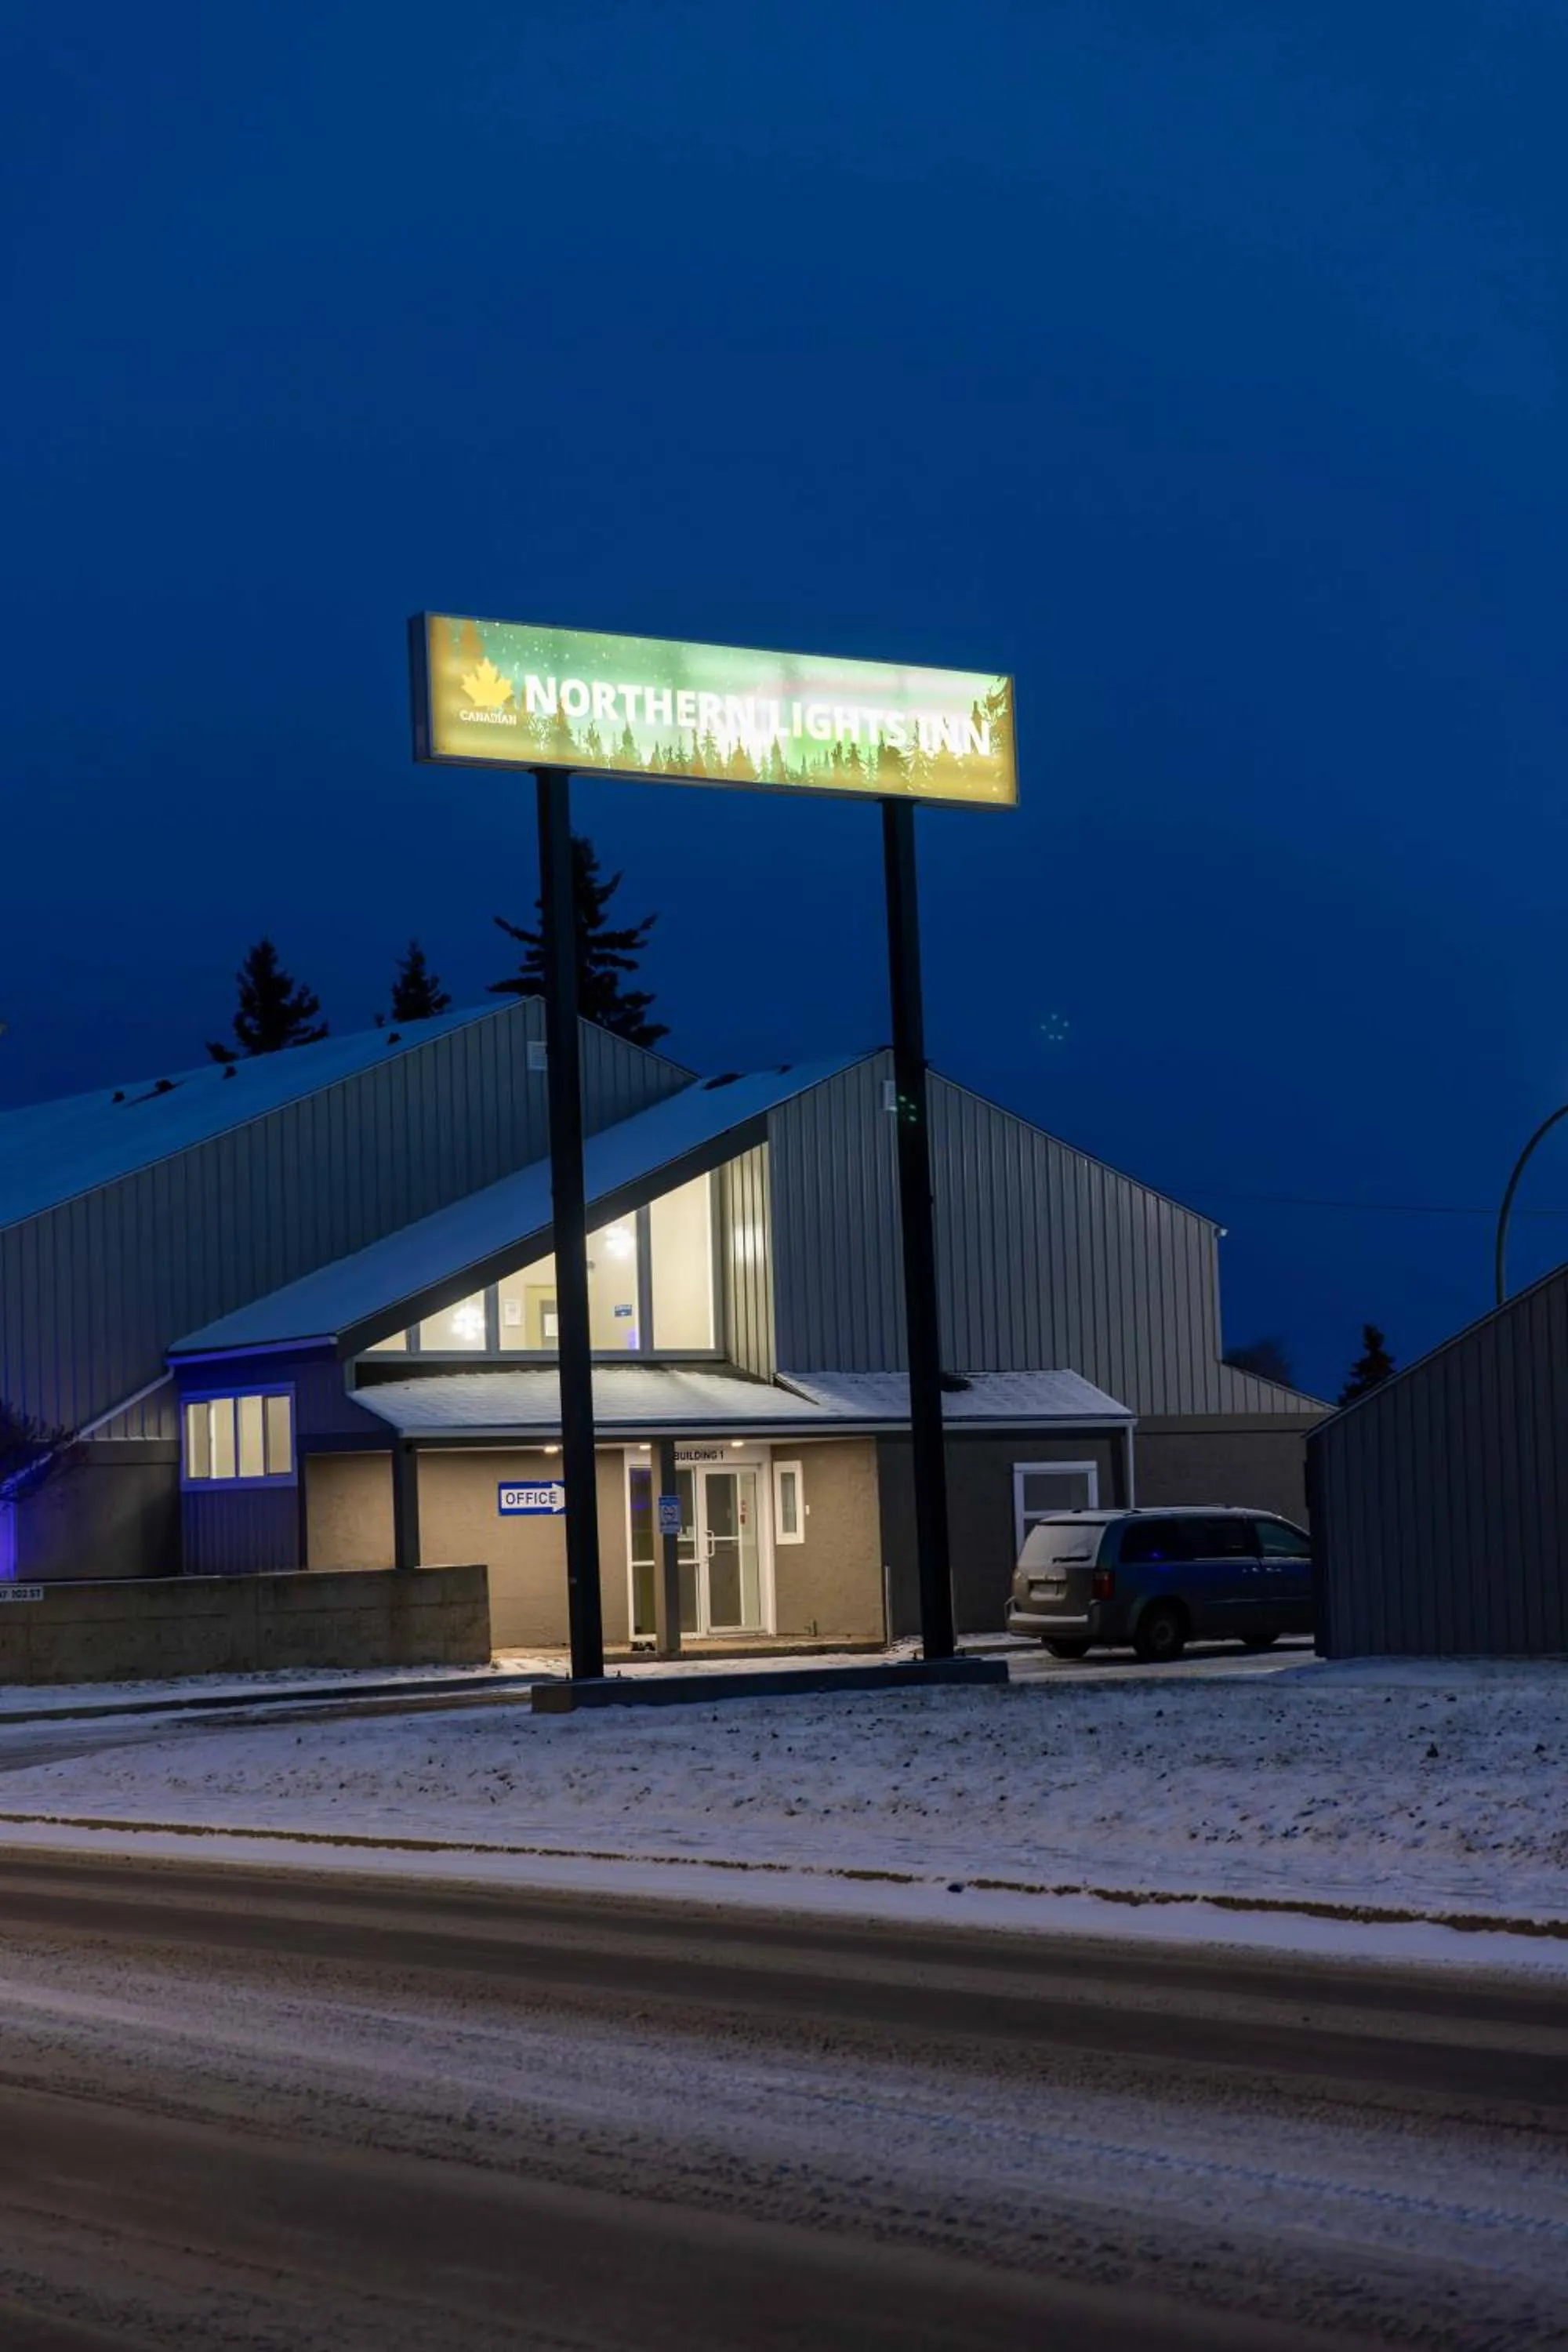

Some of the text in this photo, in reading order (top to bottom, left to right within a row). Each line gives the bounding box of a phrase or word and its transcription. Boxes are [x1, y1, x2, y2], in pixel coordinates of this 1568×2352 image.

[460, 710, 517, 725] CANADIAN
[524, 674, 991, 756] NORTHERN LIGHTS INN
[673, 1449, 724, 1461] BUILDING 1
[506, 1491, 557, 1504] OFFICE
